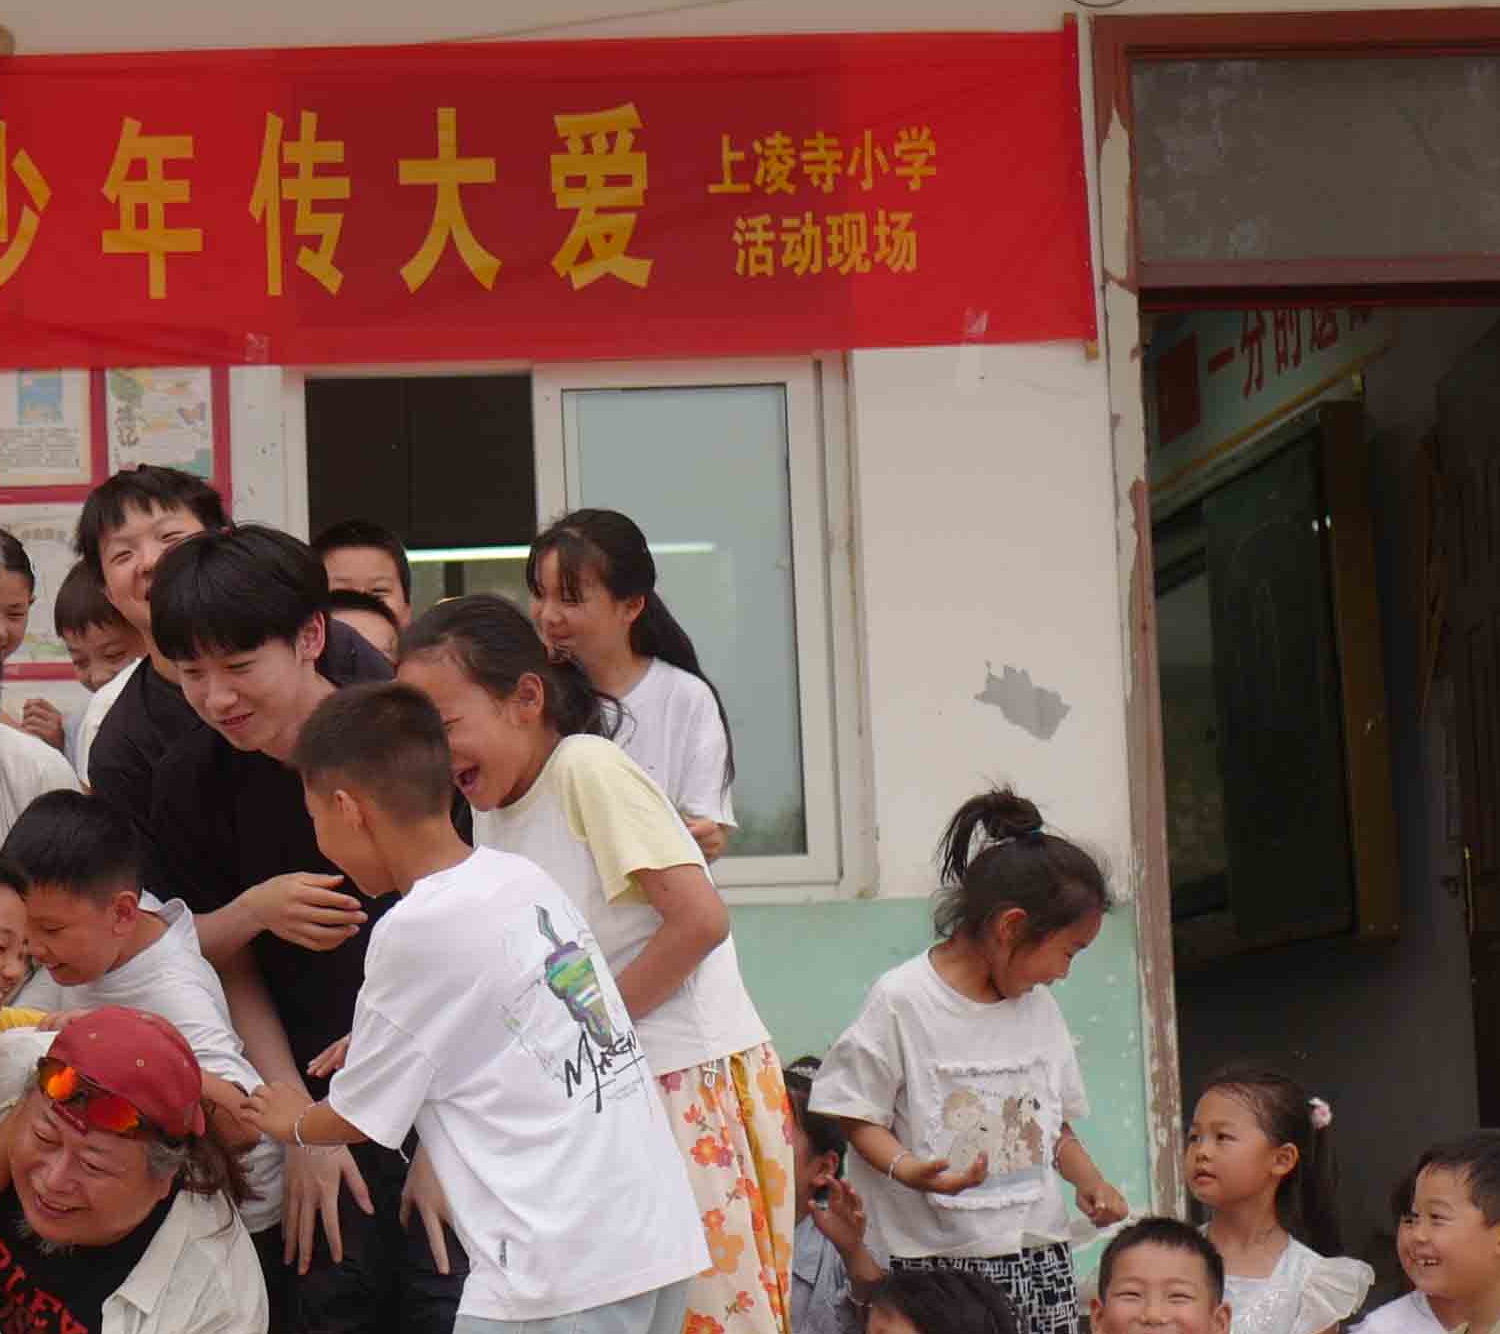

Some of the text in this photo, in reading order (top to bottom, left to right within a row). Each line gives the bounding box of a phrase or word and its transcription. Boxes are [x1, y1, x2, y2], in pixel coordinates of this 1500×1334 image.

[707, 124, 937, 195] 上凌寺小学
[731, 209, 918, 278] 活动现场
